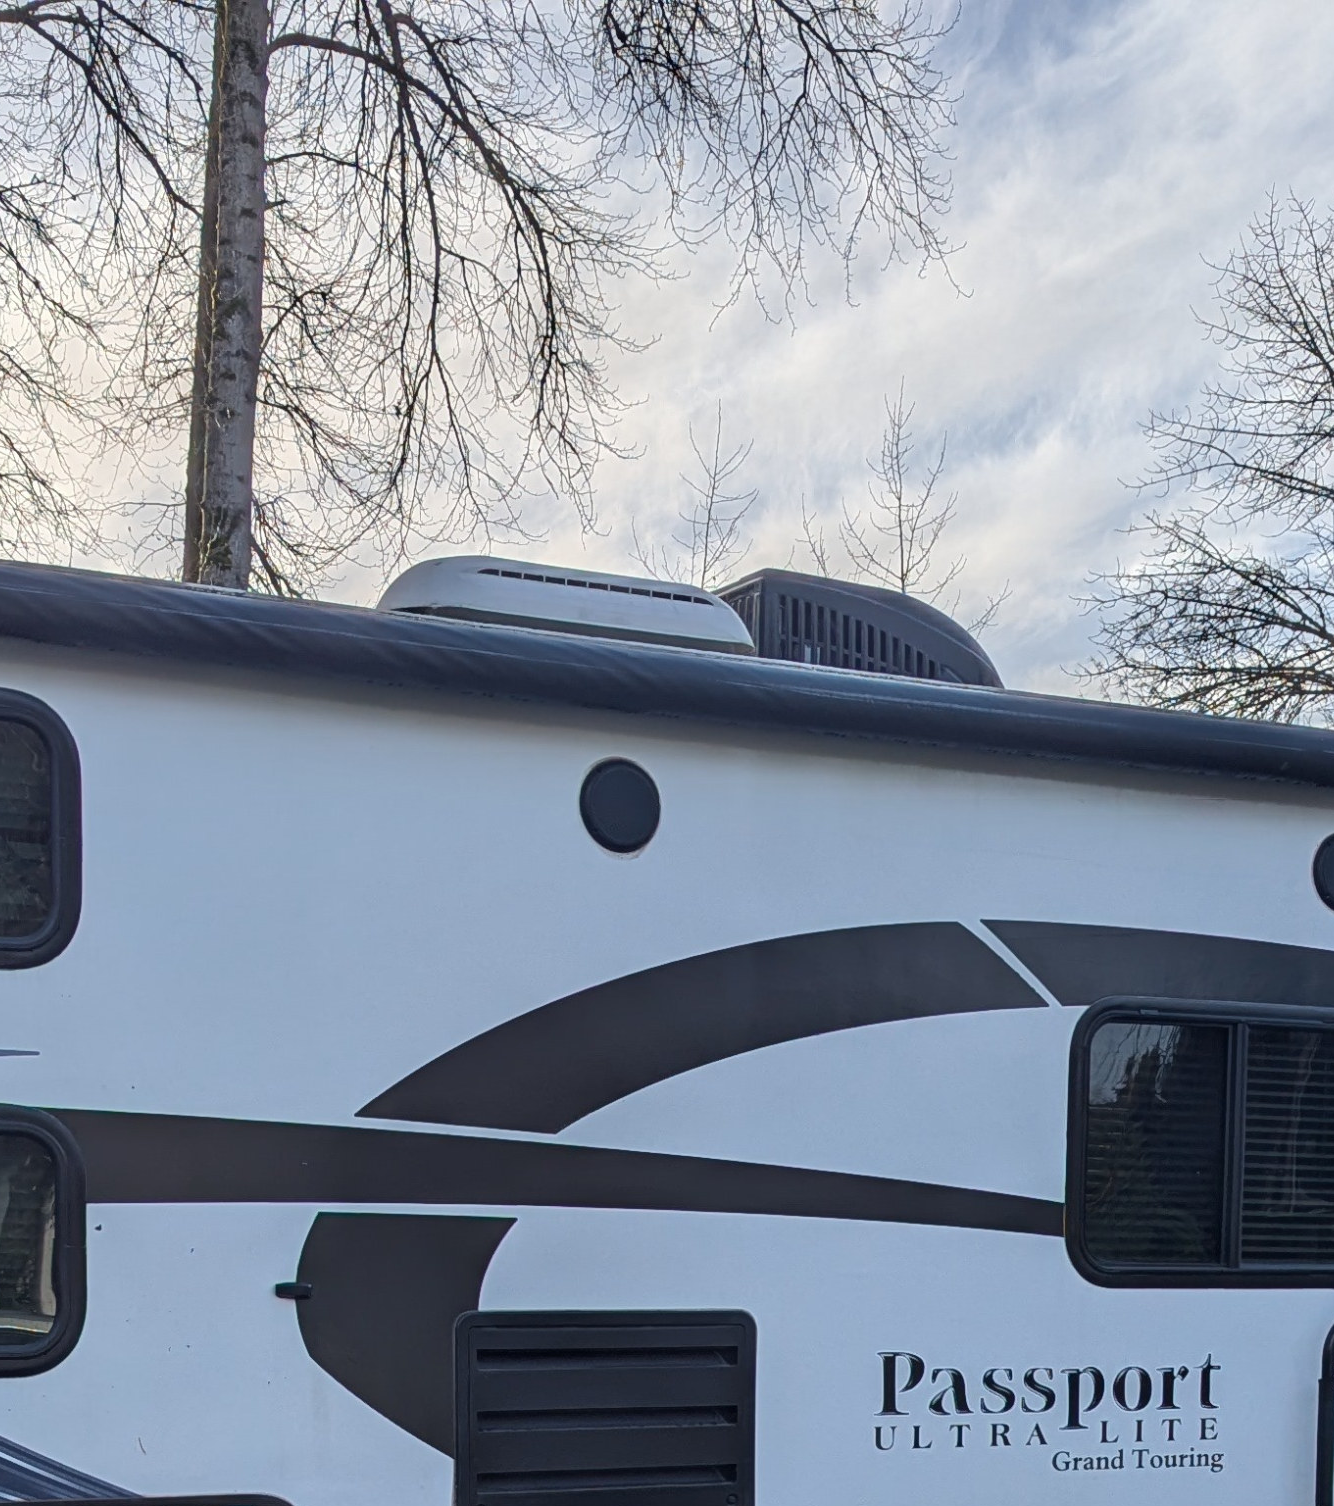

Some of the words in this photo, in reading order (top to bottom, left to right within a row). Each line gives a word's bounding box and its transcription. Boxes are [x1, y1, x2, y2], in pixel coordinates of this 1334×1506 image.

[873, 1351, 1222, 1431] Passport
[873, 1422, 1048, 1451] ULTRA
[1100, 1417, 1220, 1445] LITE
[1051, 1449, 1125, 1472] Grand
[1131, 1446, 1225, 1473] Touring
